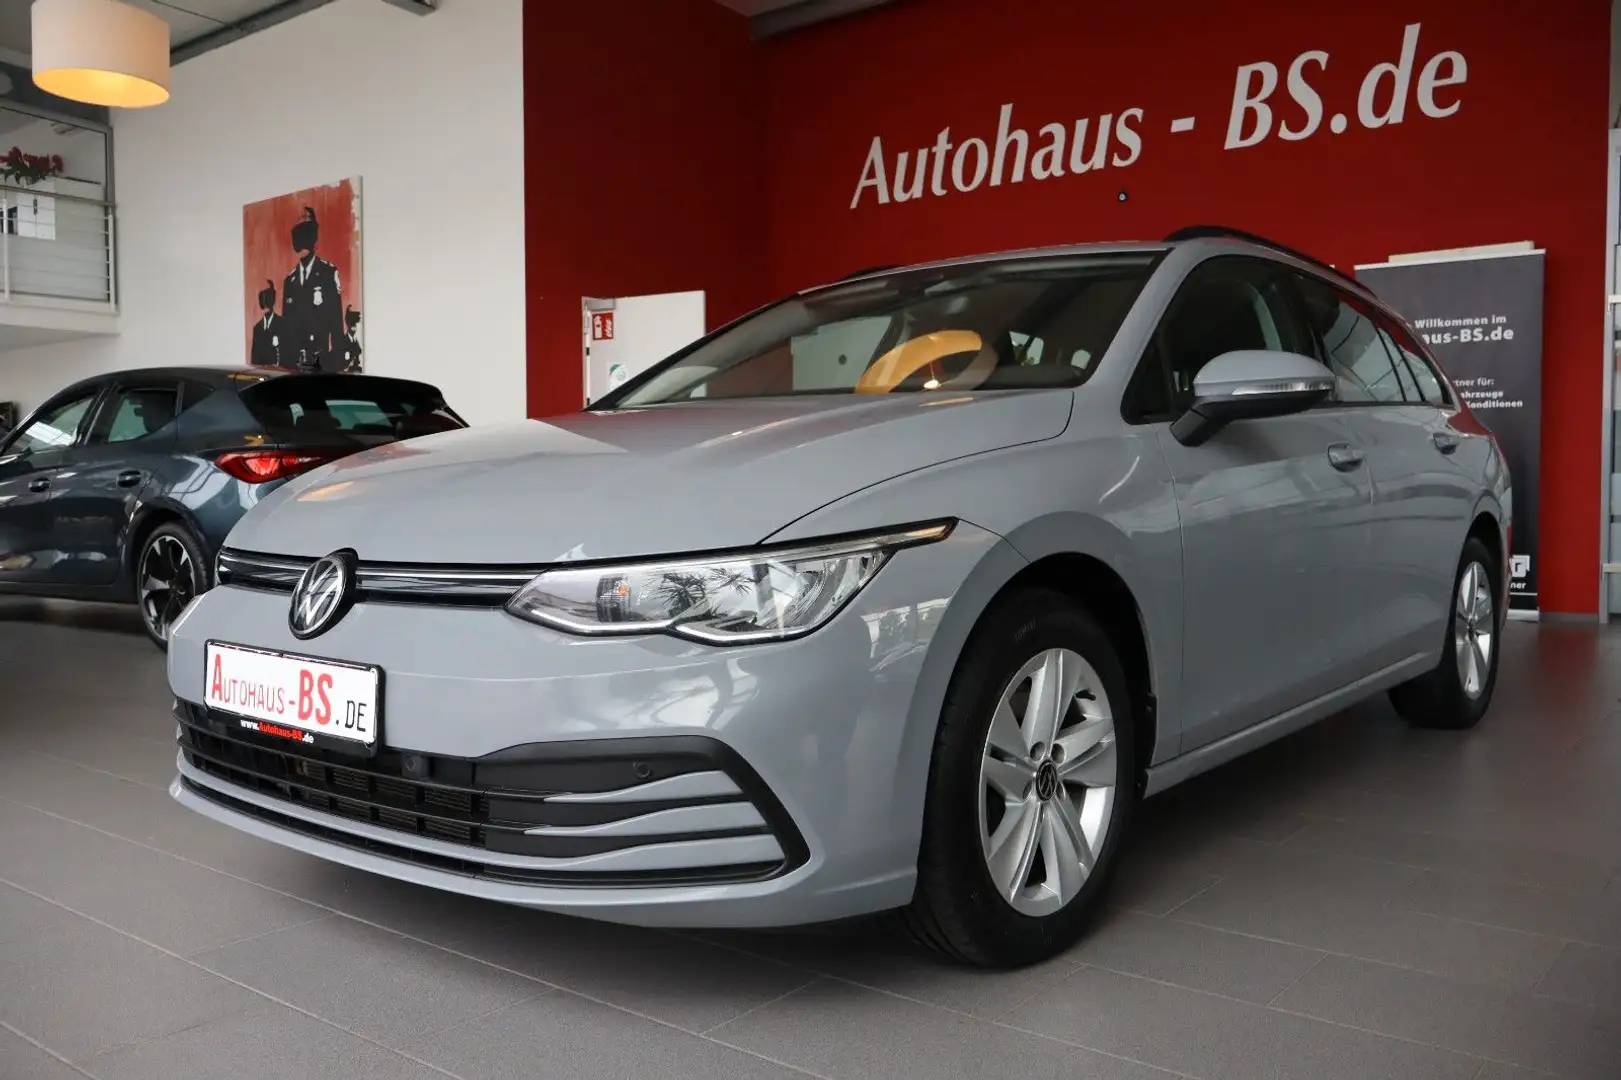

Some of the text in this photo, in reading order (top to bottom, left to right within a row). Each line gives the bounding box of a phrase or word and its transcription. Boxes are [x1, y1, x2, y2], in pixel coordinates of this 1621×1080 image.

[849, 103, 1144, 209] Autohaus
[1223, 22, 1469, 151] BS.de
[1414, 314, 1507, 329] Willkommen im
[1452, 379, 1475, 388] tner
[240, 719, 315, 744] www.Autohaus-BS.de
